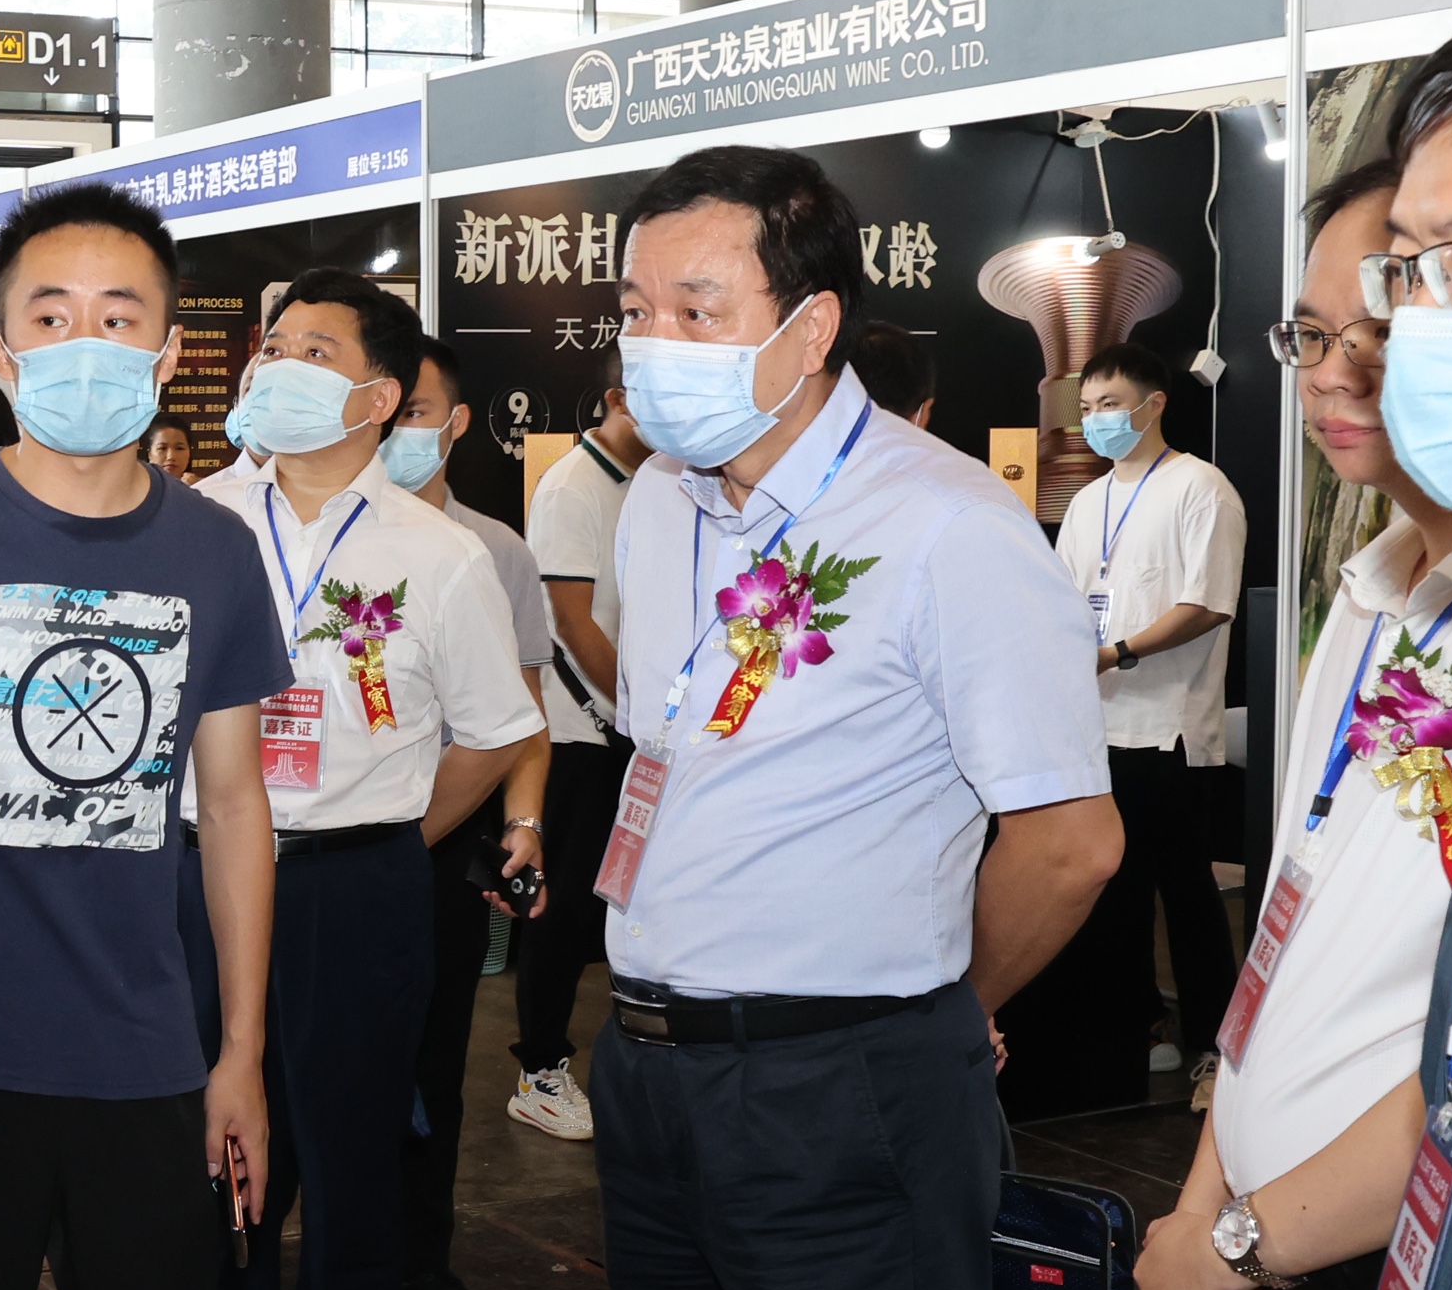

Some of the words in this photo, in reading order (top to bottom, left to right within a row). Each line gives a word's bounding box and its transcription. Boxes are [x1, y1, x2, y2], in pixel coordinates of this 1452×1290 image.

[28, 31, 107, 67] D1.1
[626, 91, 697, 125] GUANGXI
[704, 69, 837, 113] TIANLONGQUAN
[845, 56, 891, 87] WINE
[951, 40, 990, 71] LTD.
[572, 86, 614, 112] 天龙泉
[198, 297, 243, 309] PROCESS
[62, 609, 117, 627] WADE
[108, 635, 160, 654] WADE
[263, 717, 313, 737] 嘉宾证
